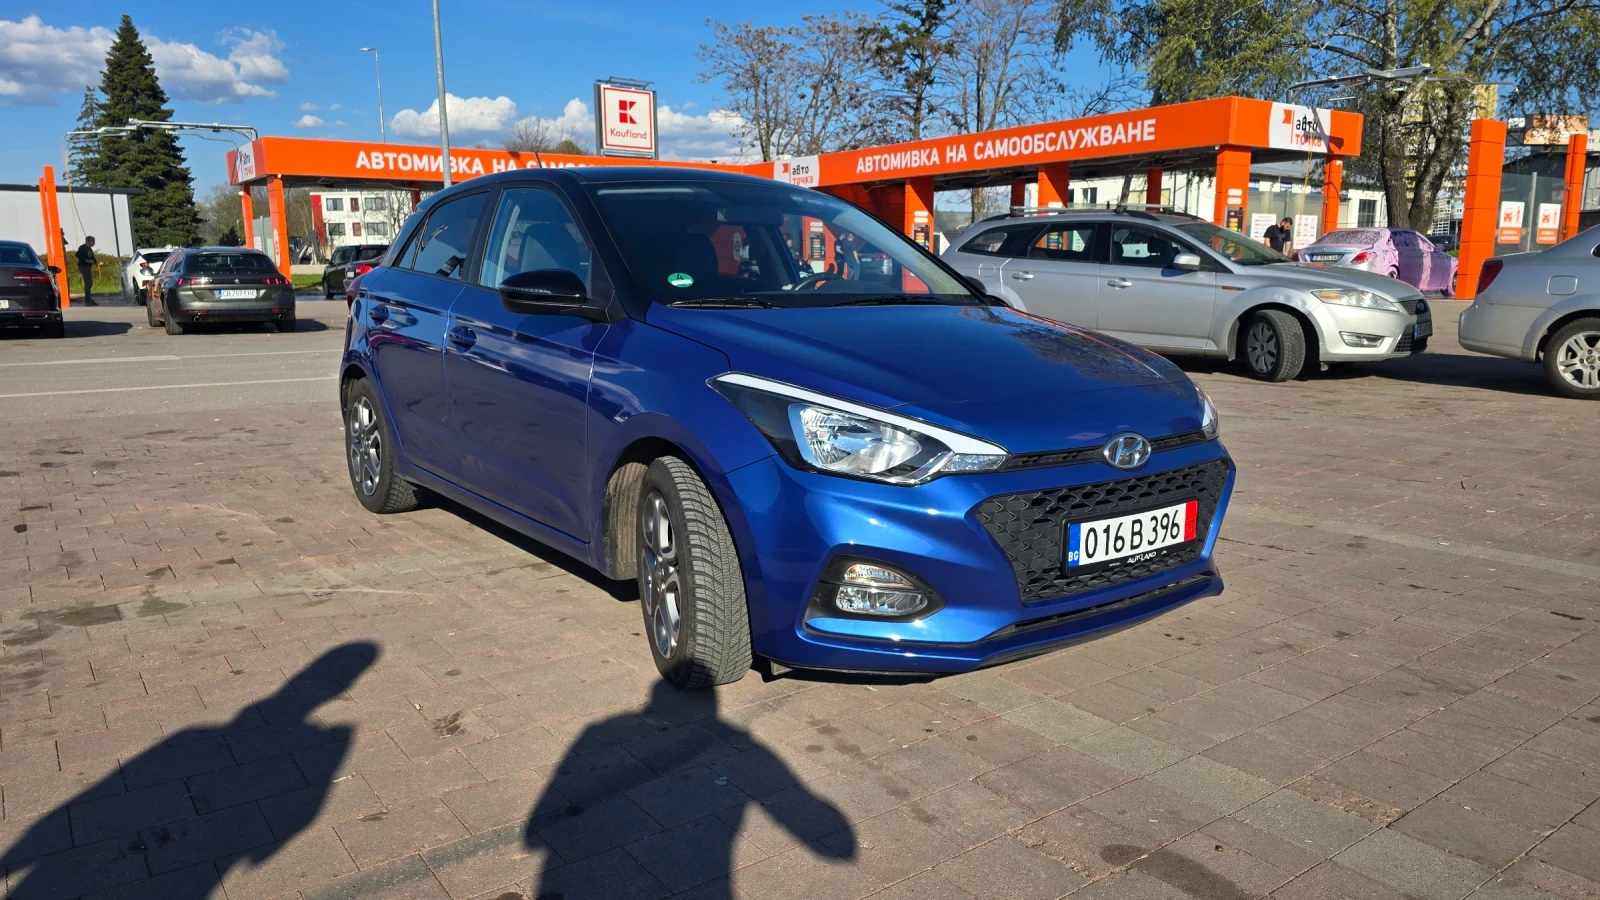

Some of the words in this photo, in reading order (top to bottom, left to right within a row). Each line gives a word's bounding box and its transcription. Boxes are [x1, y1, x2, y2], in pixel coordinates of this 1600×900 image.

[610, 127, 647, 140] Kaufland
[856, 147, 940, 174] АВТОМИВКА
[945, 143, 968, 164] НА
[973, 118, 1157, 161] САМООБСЛУЖВАНЕ
[791, 164, 810, 176] авто
[1067, 550, 1080, 562] BG
